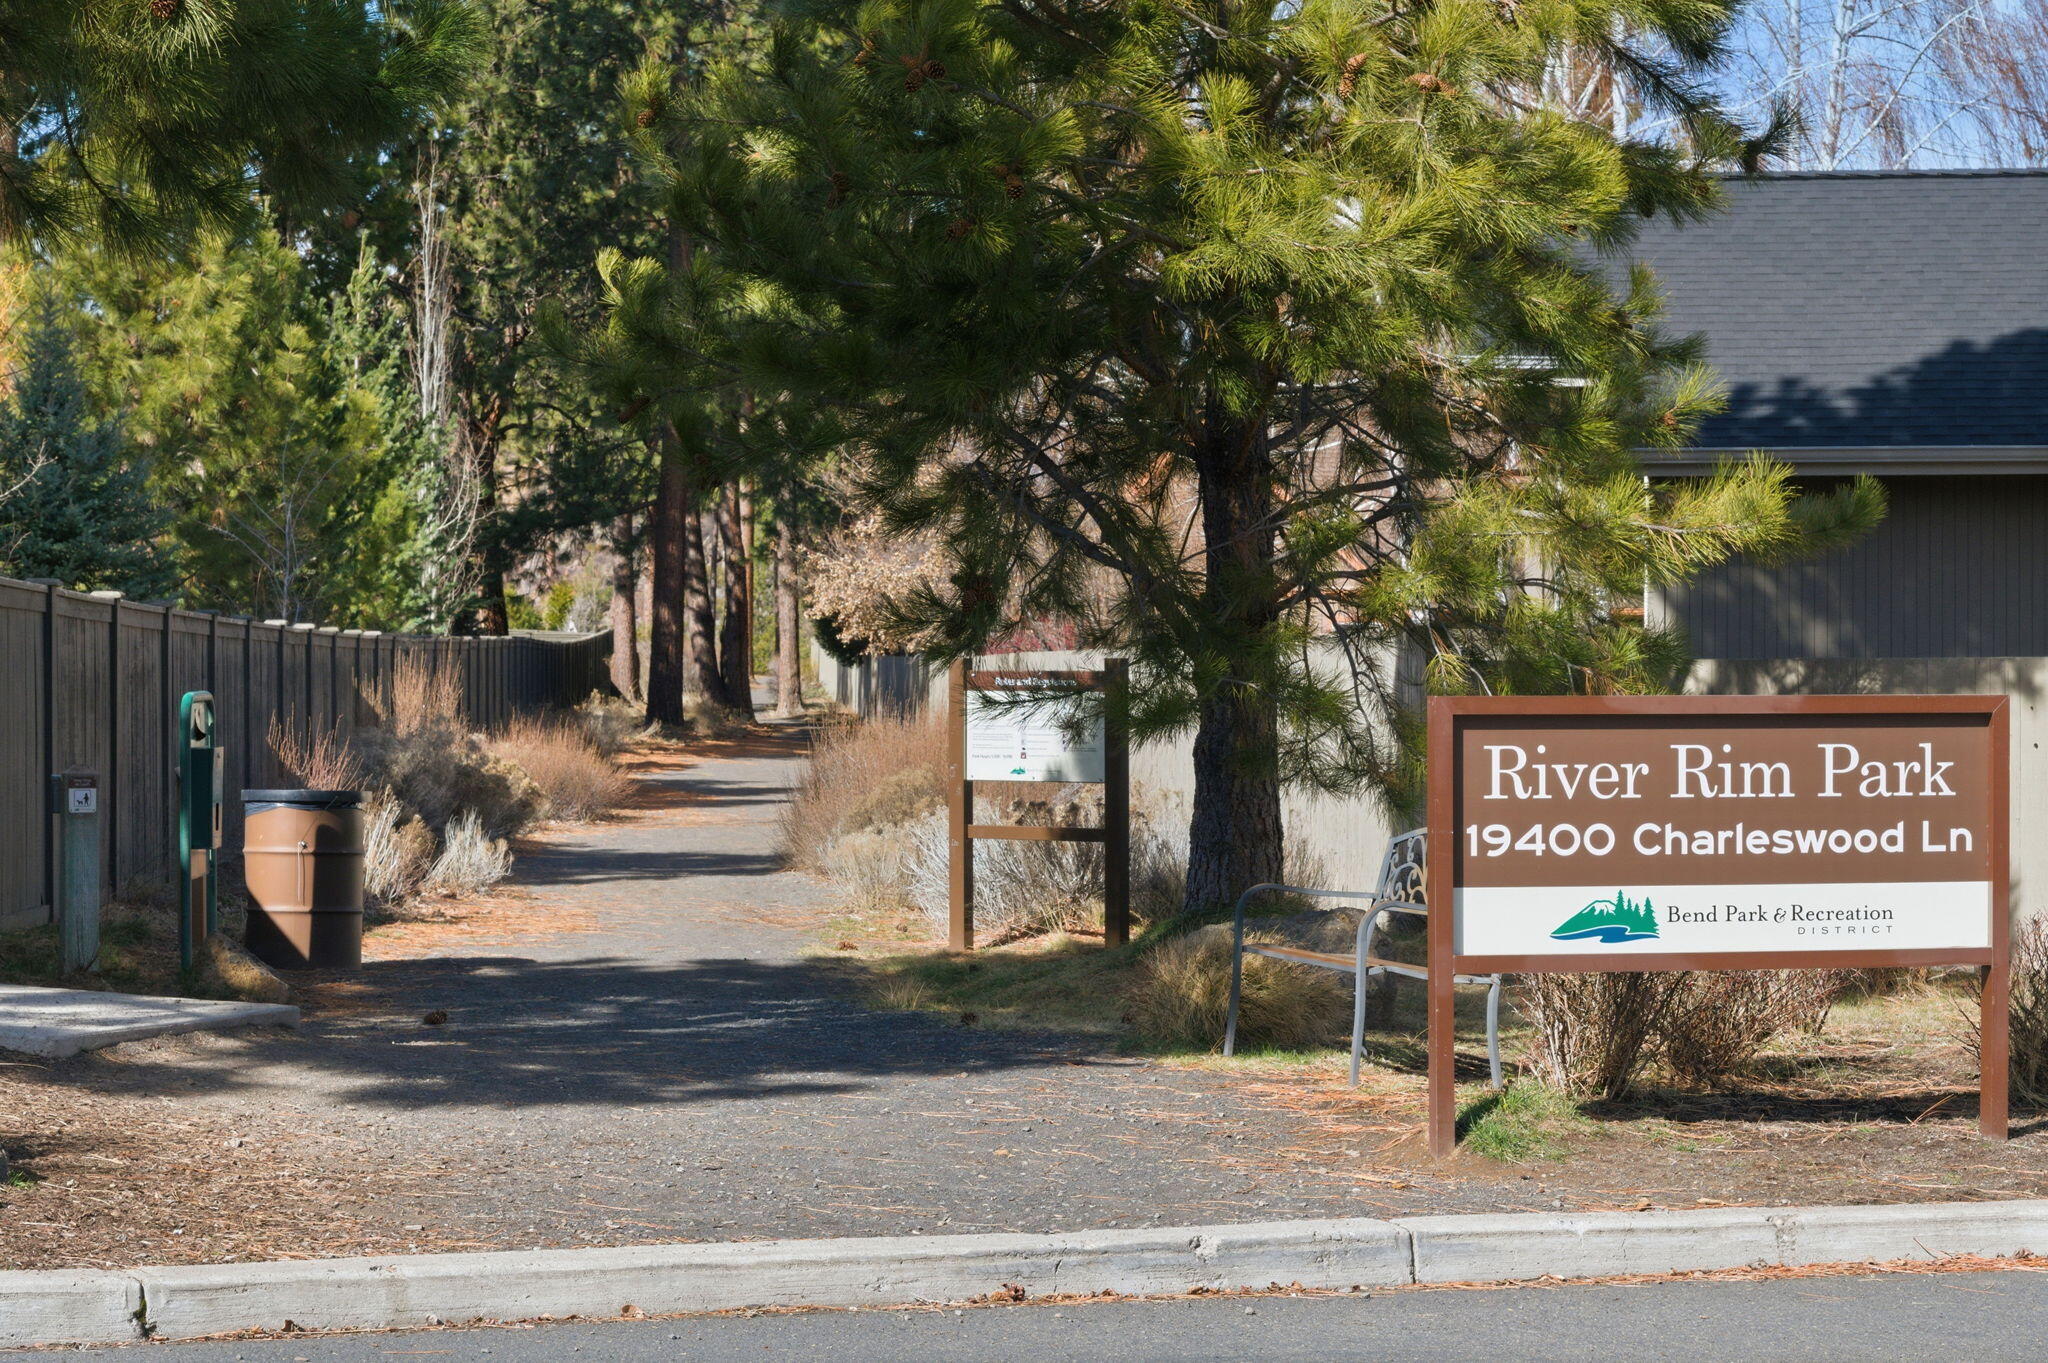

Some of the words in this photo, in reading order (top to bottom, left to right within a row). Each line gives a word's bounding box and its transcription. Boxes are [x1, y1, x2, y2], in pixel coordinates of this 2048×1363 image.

[1483, 744, 1650, 800] River
[1669, 743, 1796, 799] Rim
[1817, 742, 1957, 798] Park
[1465, 822, 1616, 858] 19400
[1632, 820, 1905, 856] Charleswood
[1922, 820, 1973, 853] Ln
[1668, 904, 1718, 923] Bend
[1725, 904, 1768, 923] Park
[1773, 907, 1787, 924] &
[1791, 904, 1893, 922] Recreation
[1797, 925, 1894, 935] DISTRICT
